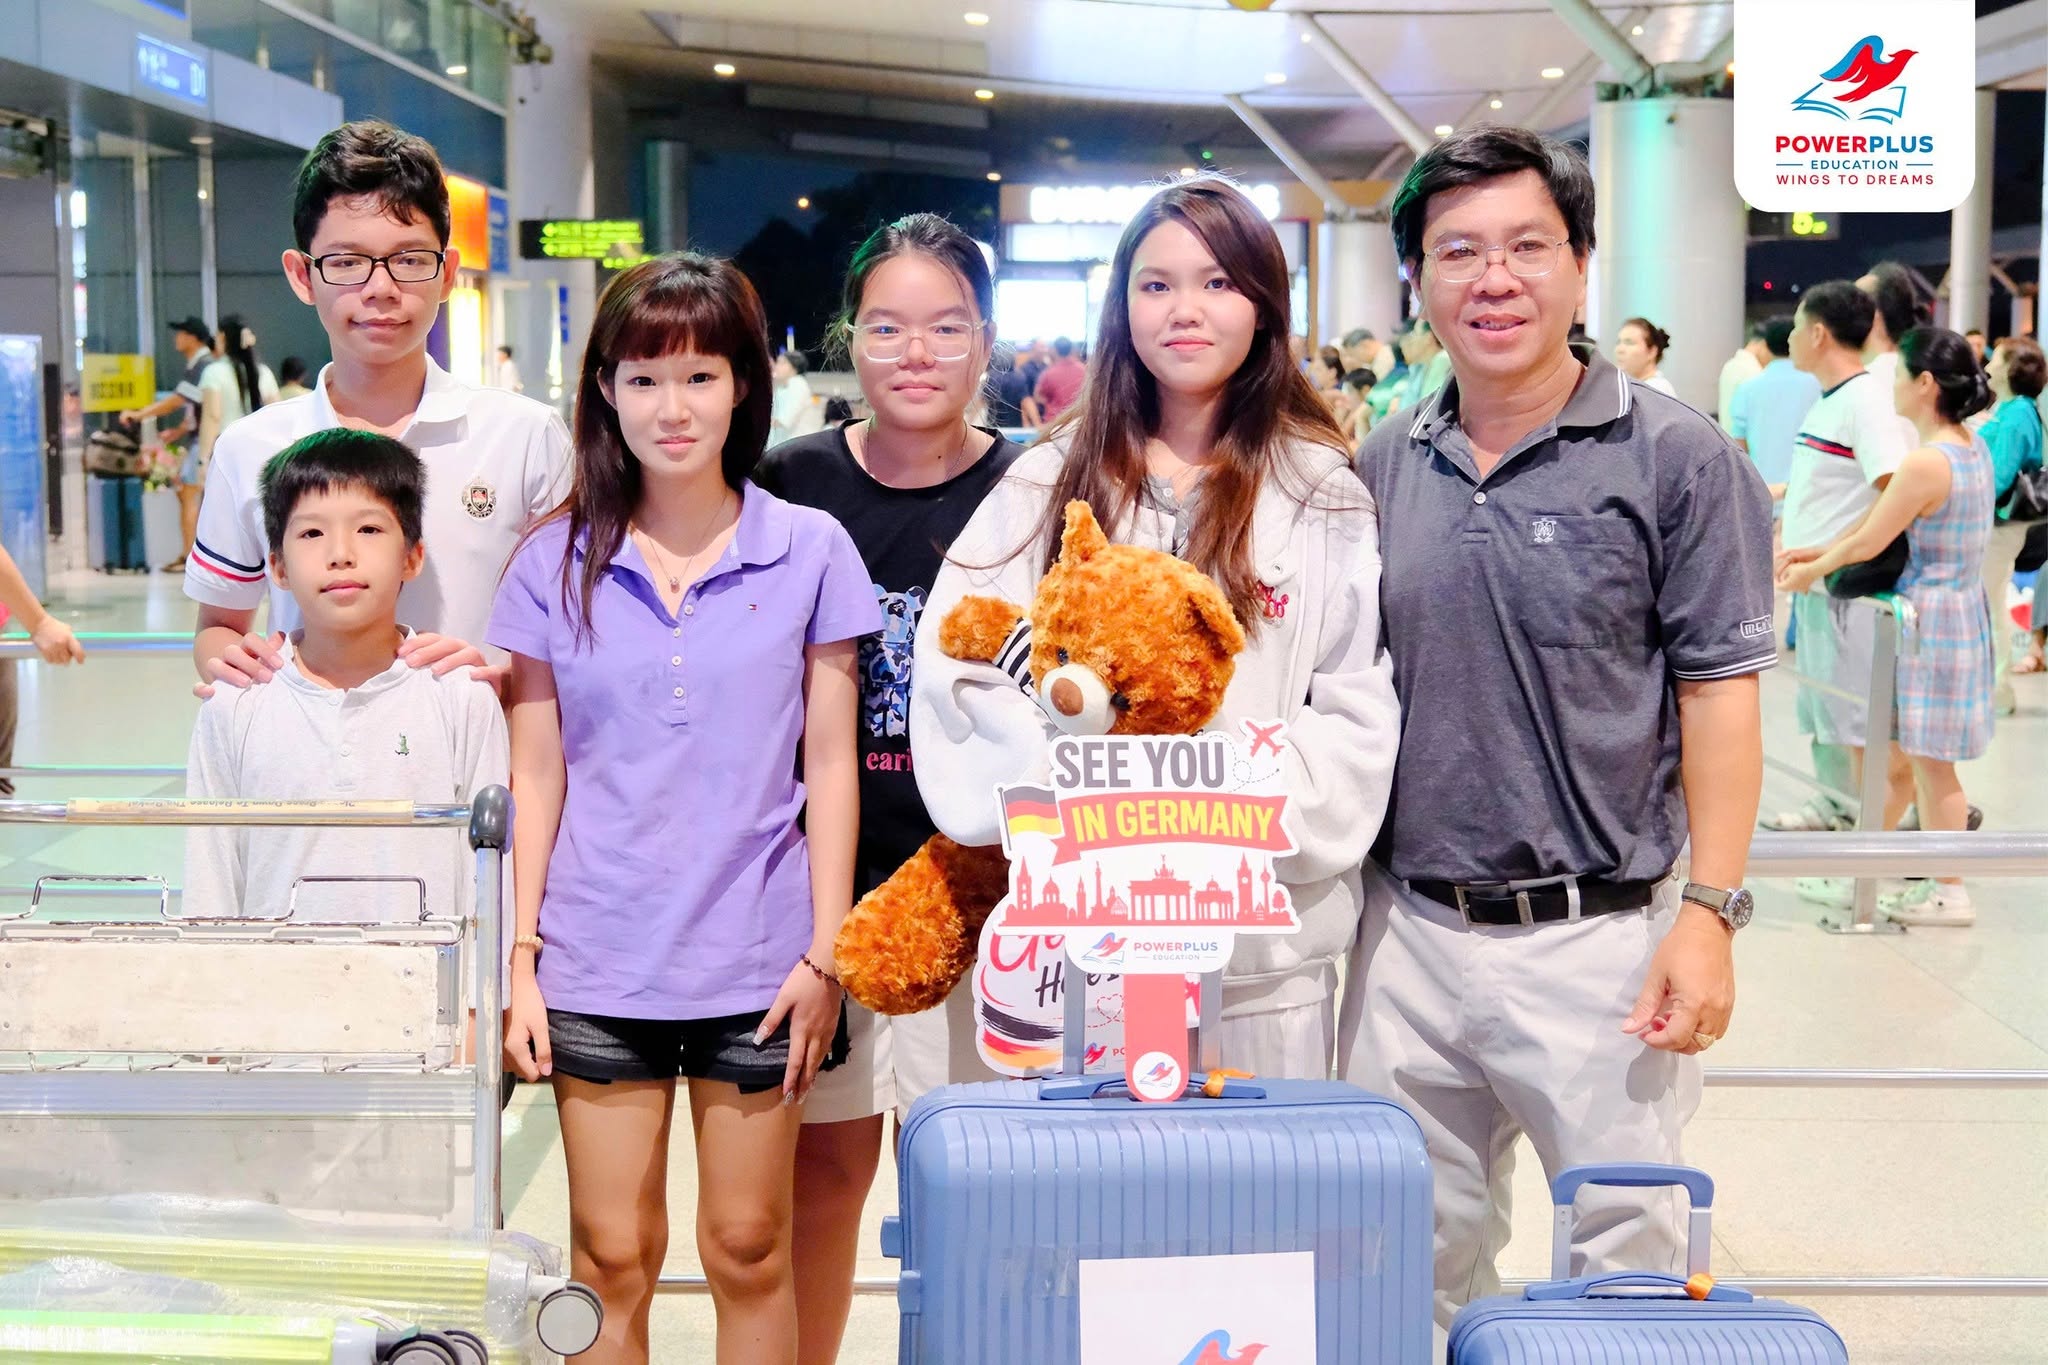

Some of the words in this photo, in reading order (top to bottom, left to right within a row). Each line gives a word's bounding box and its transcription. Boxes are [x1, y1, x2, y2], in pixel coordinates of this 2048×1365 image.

[1055, 741, 1131, 788] SEE
[1142, 741, 1225, 788] YOU
[1071, 803, 1108, 843] IN
[1115, 799, 1274, 841] GERMANY
[1134, 942, 1218, 951] POWERPLUS
